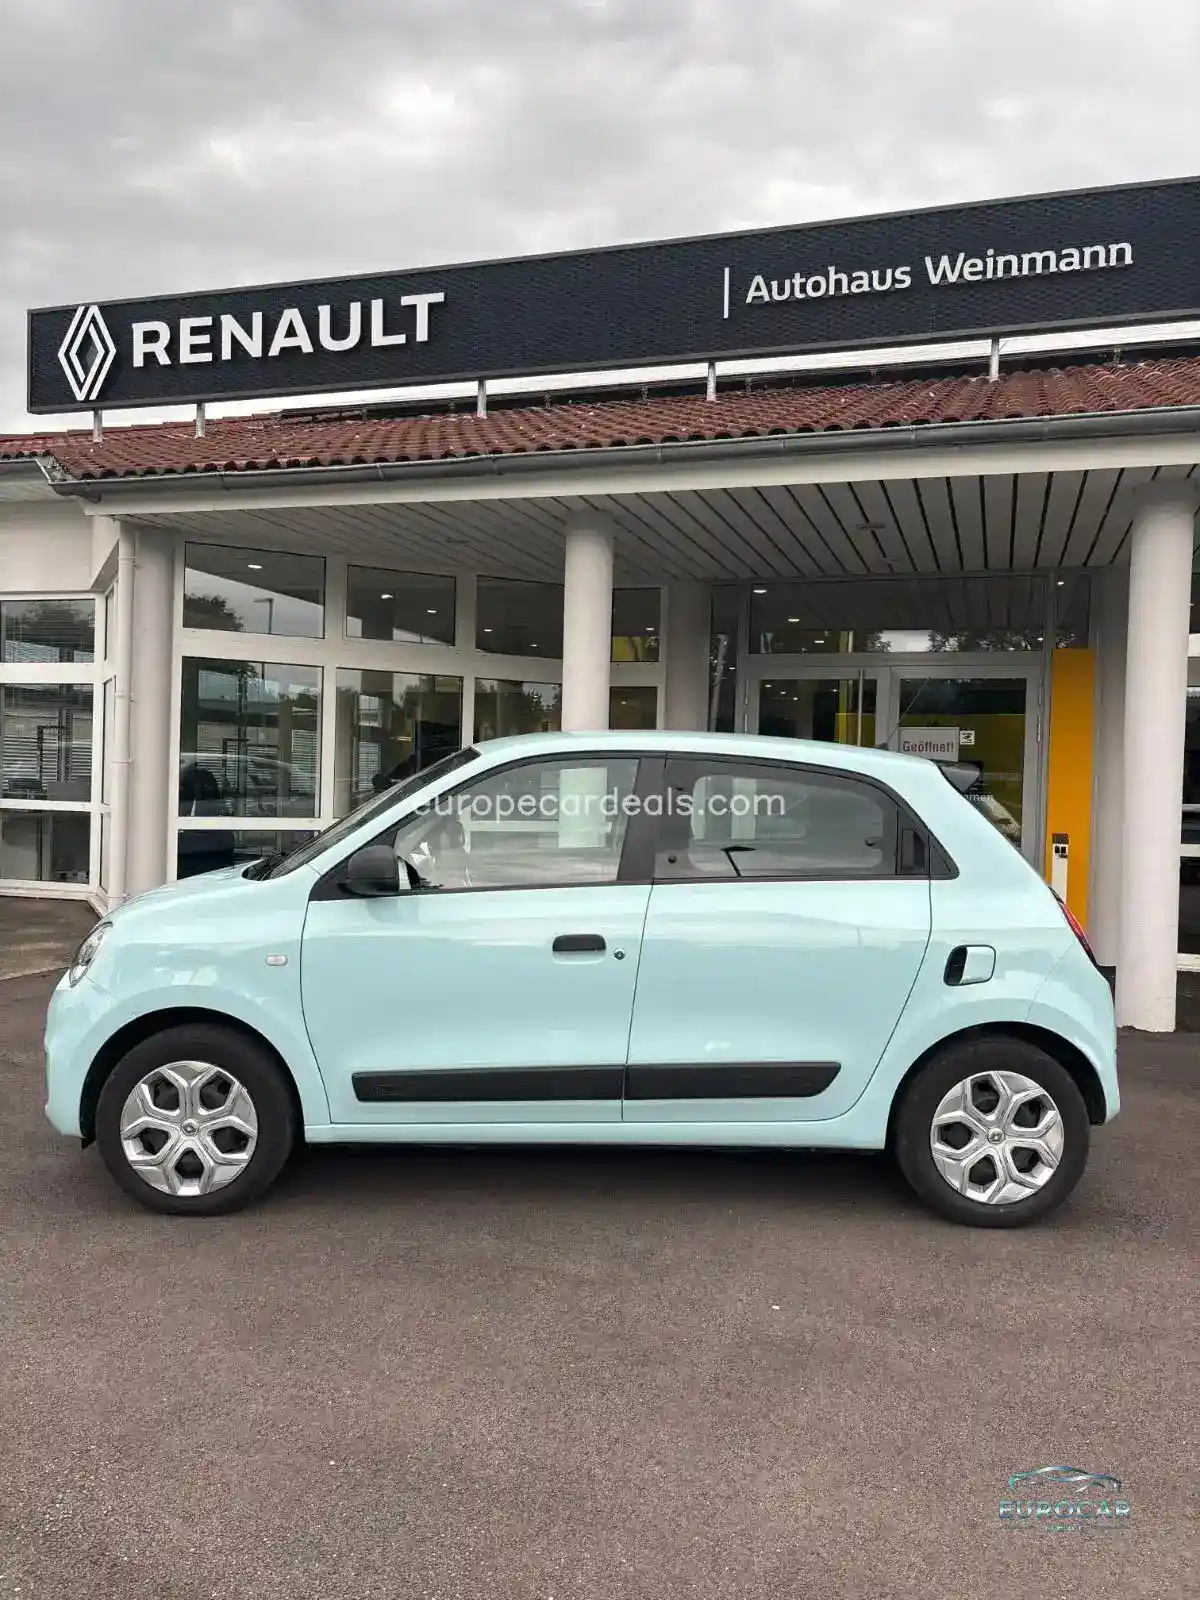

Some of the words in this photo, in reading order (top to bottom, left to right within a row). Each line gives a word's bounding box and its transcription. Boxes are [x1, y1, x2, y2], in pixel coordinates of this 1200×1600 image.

[745, 266, 911, 304] Autohaus
[925, 241, 1133, 285] Weinmann
[132, 292, 445, 368] RENAULT
